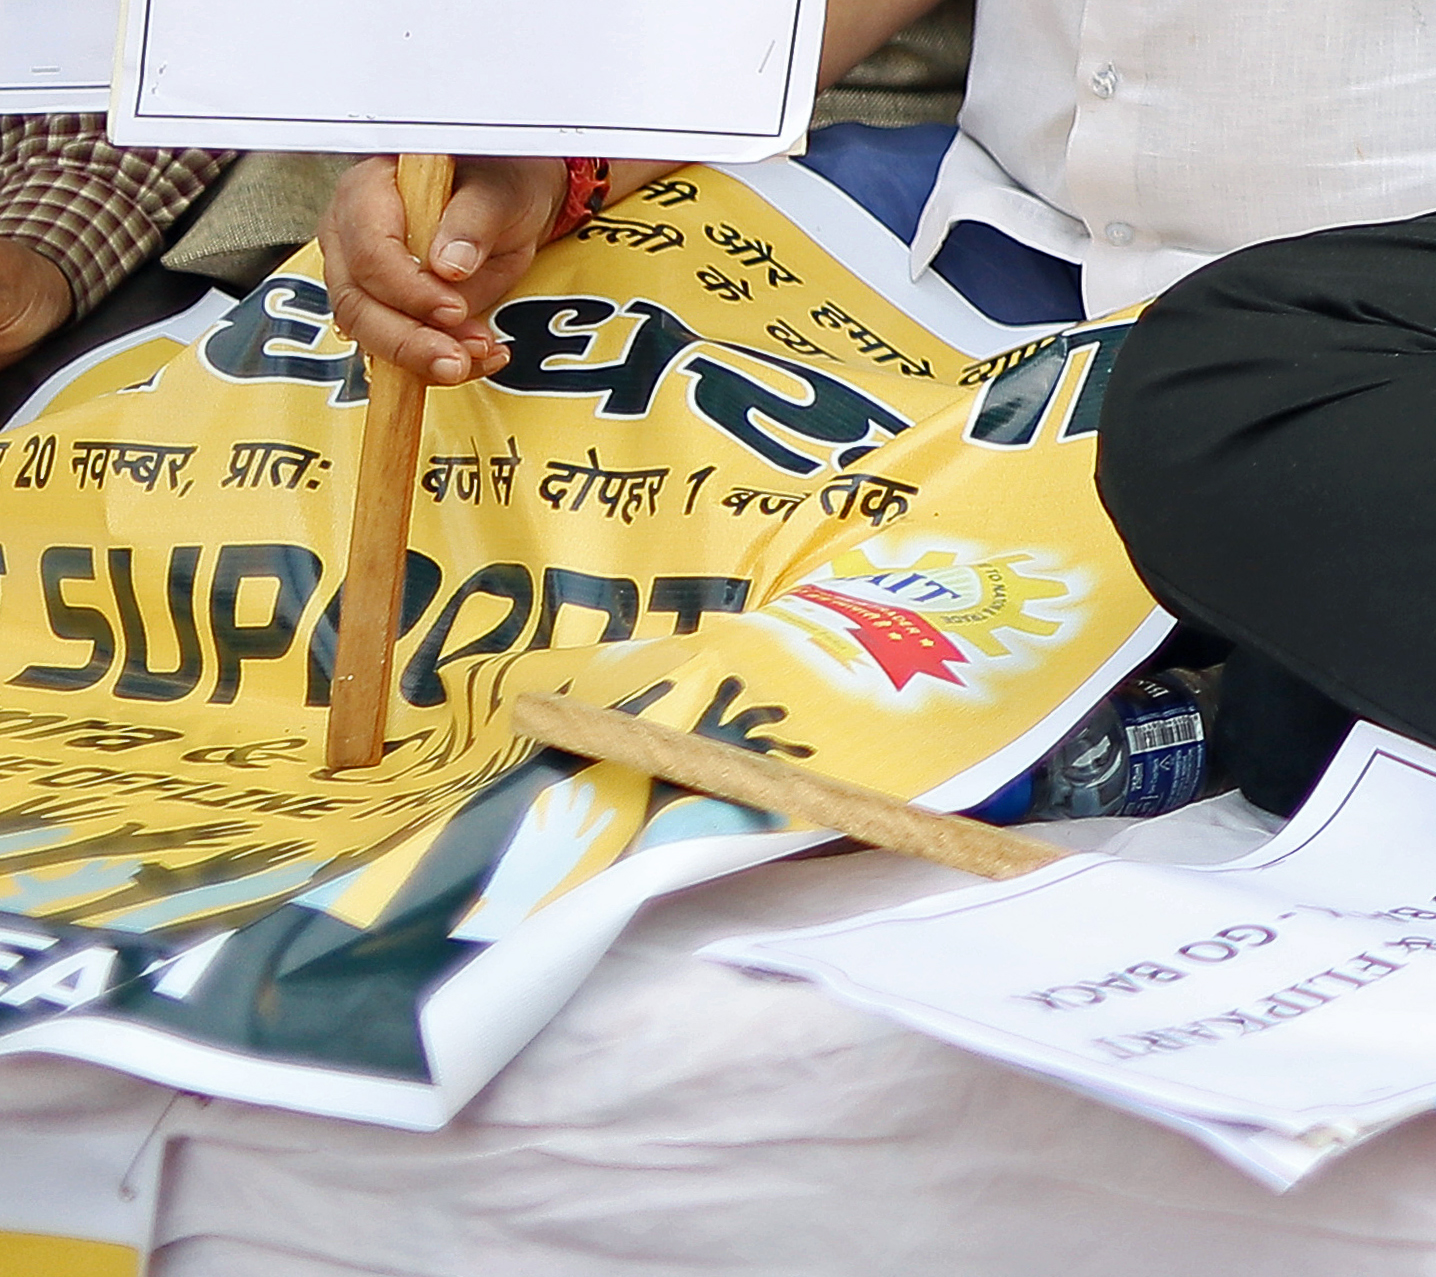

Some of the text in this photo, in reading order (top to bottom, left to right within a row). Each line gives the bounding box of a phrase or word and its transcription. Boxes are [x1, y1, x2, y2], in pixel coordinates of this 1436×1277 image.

[697, 266, 753, 302] के
[706, 223, 803, 288] और
[810, 301, 935, 380] हमारे
[15, 434, 55, 489] 20
[489, 437, 519, 505] से
[540, 449, 669, 524] दोपहर
[684, 467, 716, 515] 1
[822, 473, 919, 527] तक
[1178, 924, 1278, 964] GO
[1009, 961, 1189, 1012] BACK
[1089, 951, 1410, 1060] FLIPKART
